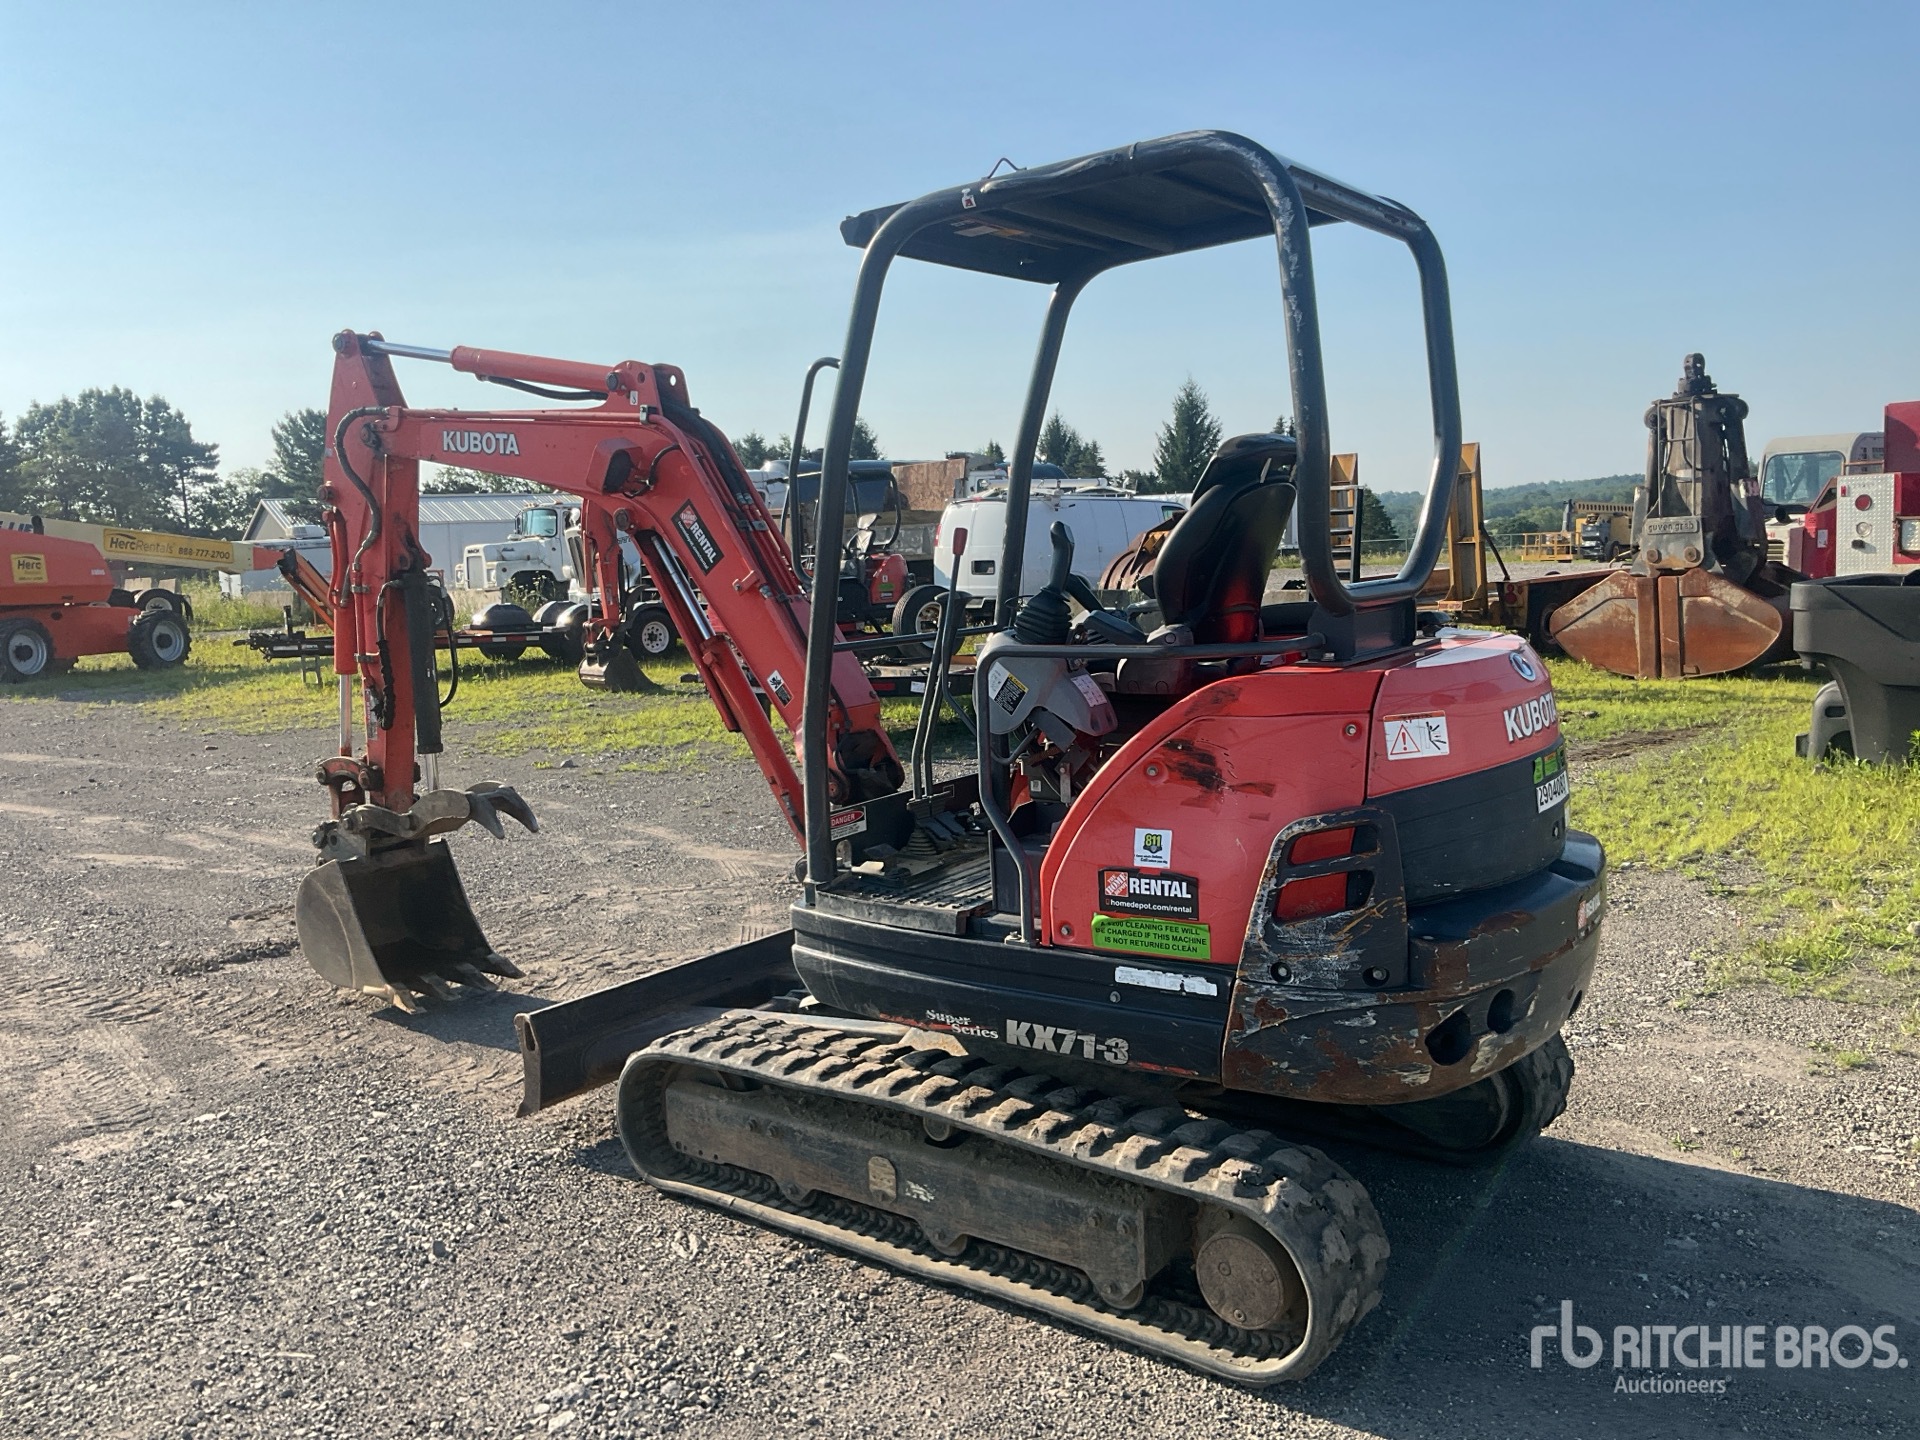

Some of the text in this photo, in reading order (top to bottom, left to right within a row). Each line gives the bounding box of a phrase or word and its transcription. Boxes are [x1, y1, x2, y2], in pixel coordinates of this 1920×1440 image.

[443, 431, 520, 455] KUBOTA
[690, 522, 717, 563] RENTAL
[17, 560, 42, 570] Herc
[831, 813, 855, 826] DANGER
[1145, 834, 1161, 847] 811
[1105, 872, 1128, 895] HOME
[1129, 877, 1192, 899] RENTAL
[1110, 899, 1192, 913] homedepot.com/rental
[1125, 921, 1163, 931] CLEANING
[1165, 925, 1180, 933] FEE
[1107, 928, 1143, 938] CHARGED
[1171, 936, 1207, 945] MACHINE
[1129, 939, 1171, 950] RETURNED
[1171, 944, 1198, 953] CLEAN
[926, 1009, 972, 1026] Super
[951, 1023, 999, 1039] Series
[1006, 1019, 1130, 1065] KX71-3
